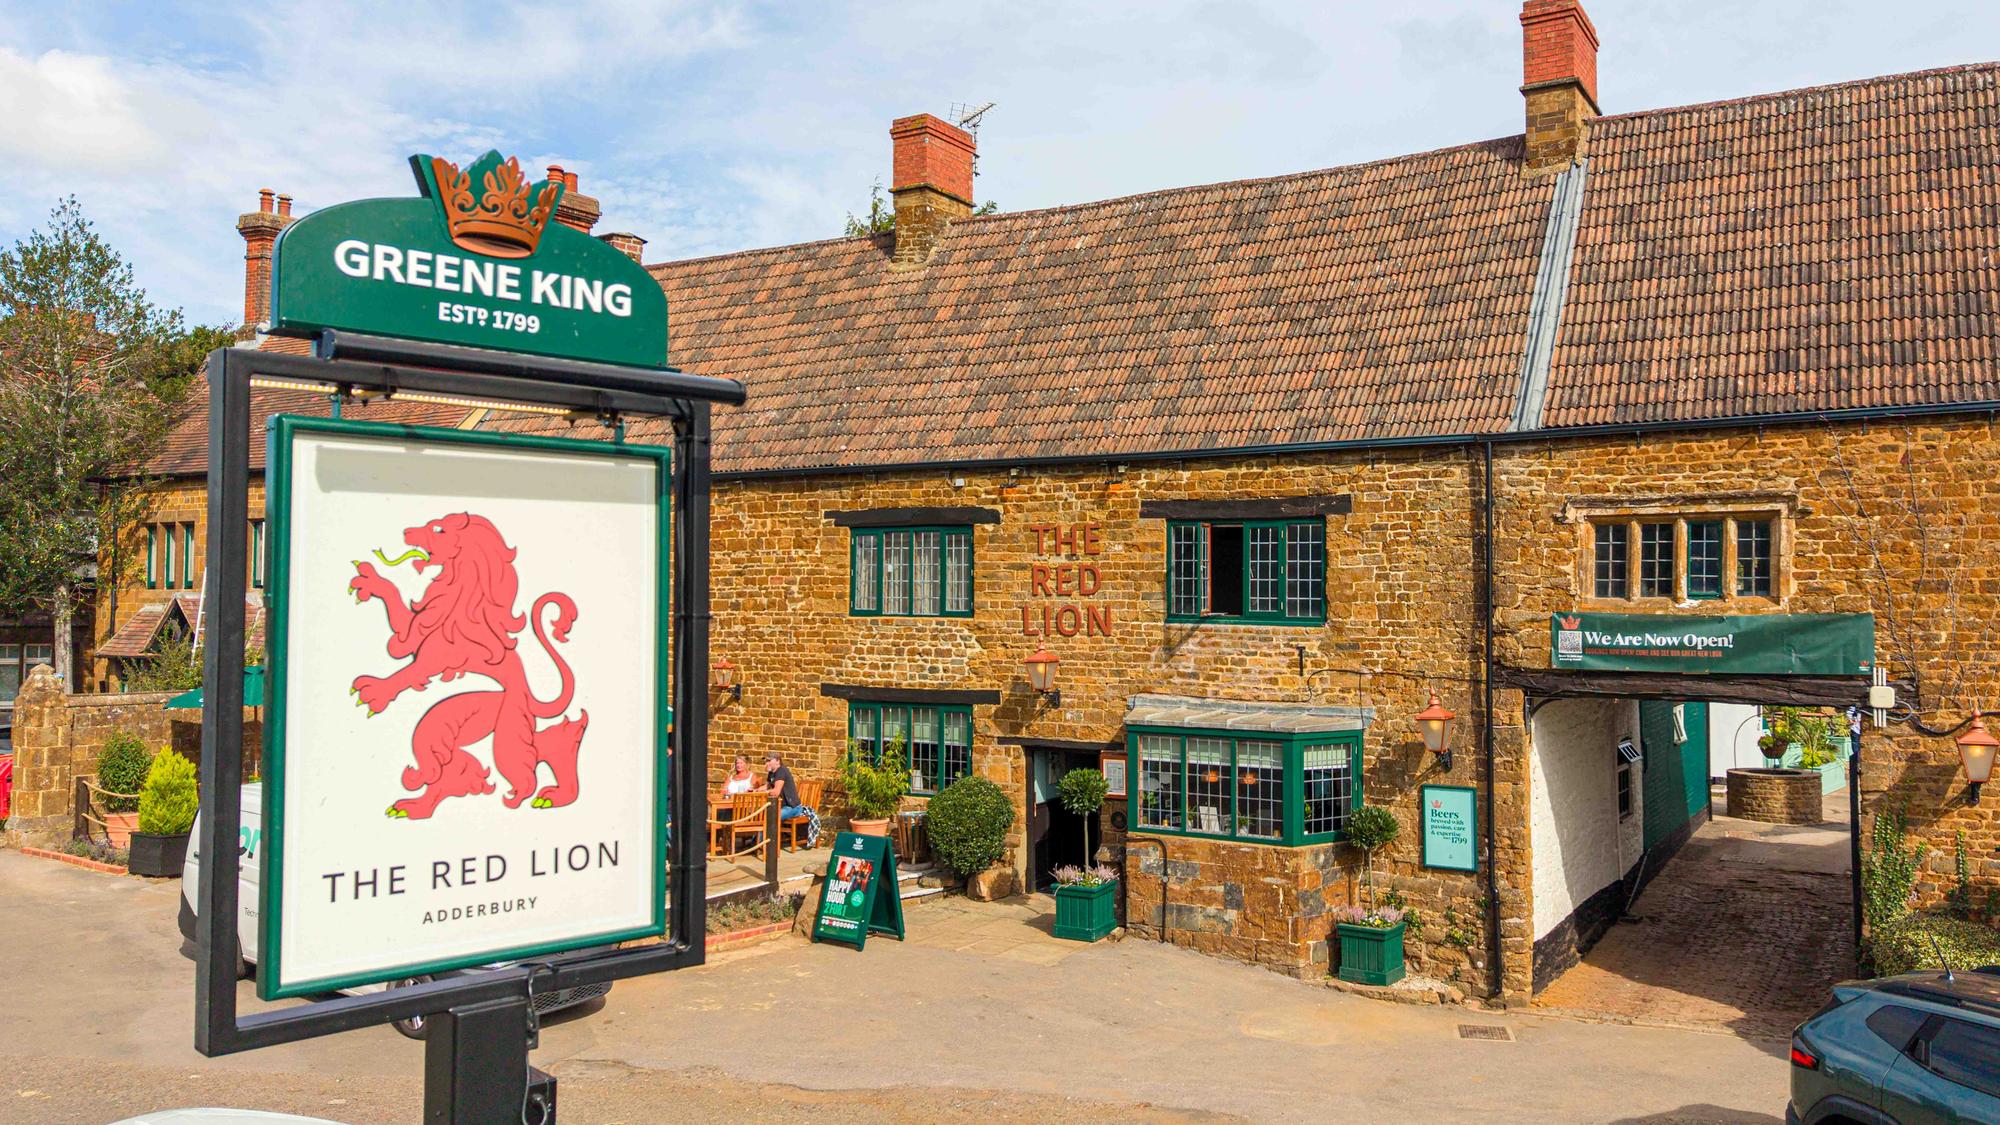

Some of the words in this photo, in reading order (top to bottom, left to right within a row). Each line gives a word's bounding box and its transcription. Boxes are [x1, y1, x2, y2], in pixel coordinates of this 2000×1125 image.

[333, 240, 521, 301] GREENE
[531, 270, 632, 317] KING
[492, 309, 540, 334] 1799
[1030, 522, 1101, 556] THE
[1032, 563, 1101, 596] RED
[1023, 604, 1112, 637] LION
[1584, 631, 1611, 645] We
[1613, 632, 1642, 646] Are
[1644, 632, 1681, 647] Now
[1683, 633, 1734, 649] Open!
[1431, 809, 1459, 819] Beers
[322, 865, 407, 903] THE
[431, 854, 508, 890] RED
[531, 840, 620, 877] LION
[827, 891, 846, 905] HOUR
[829, 879, 852, 893] HAPPY
[422, 896, 538, 925] ADDERBURY
[824, 903, 830, 914] 2
[830, 904, 843, 916] FOR
